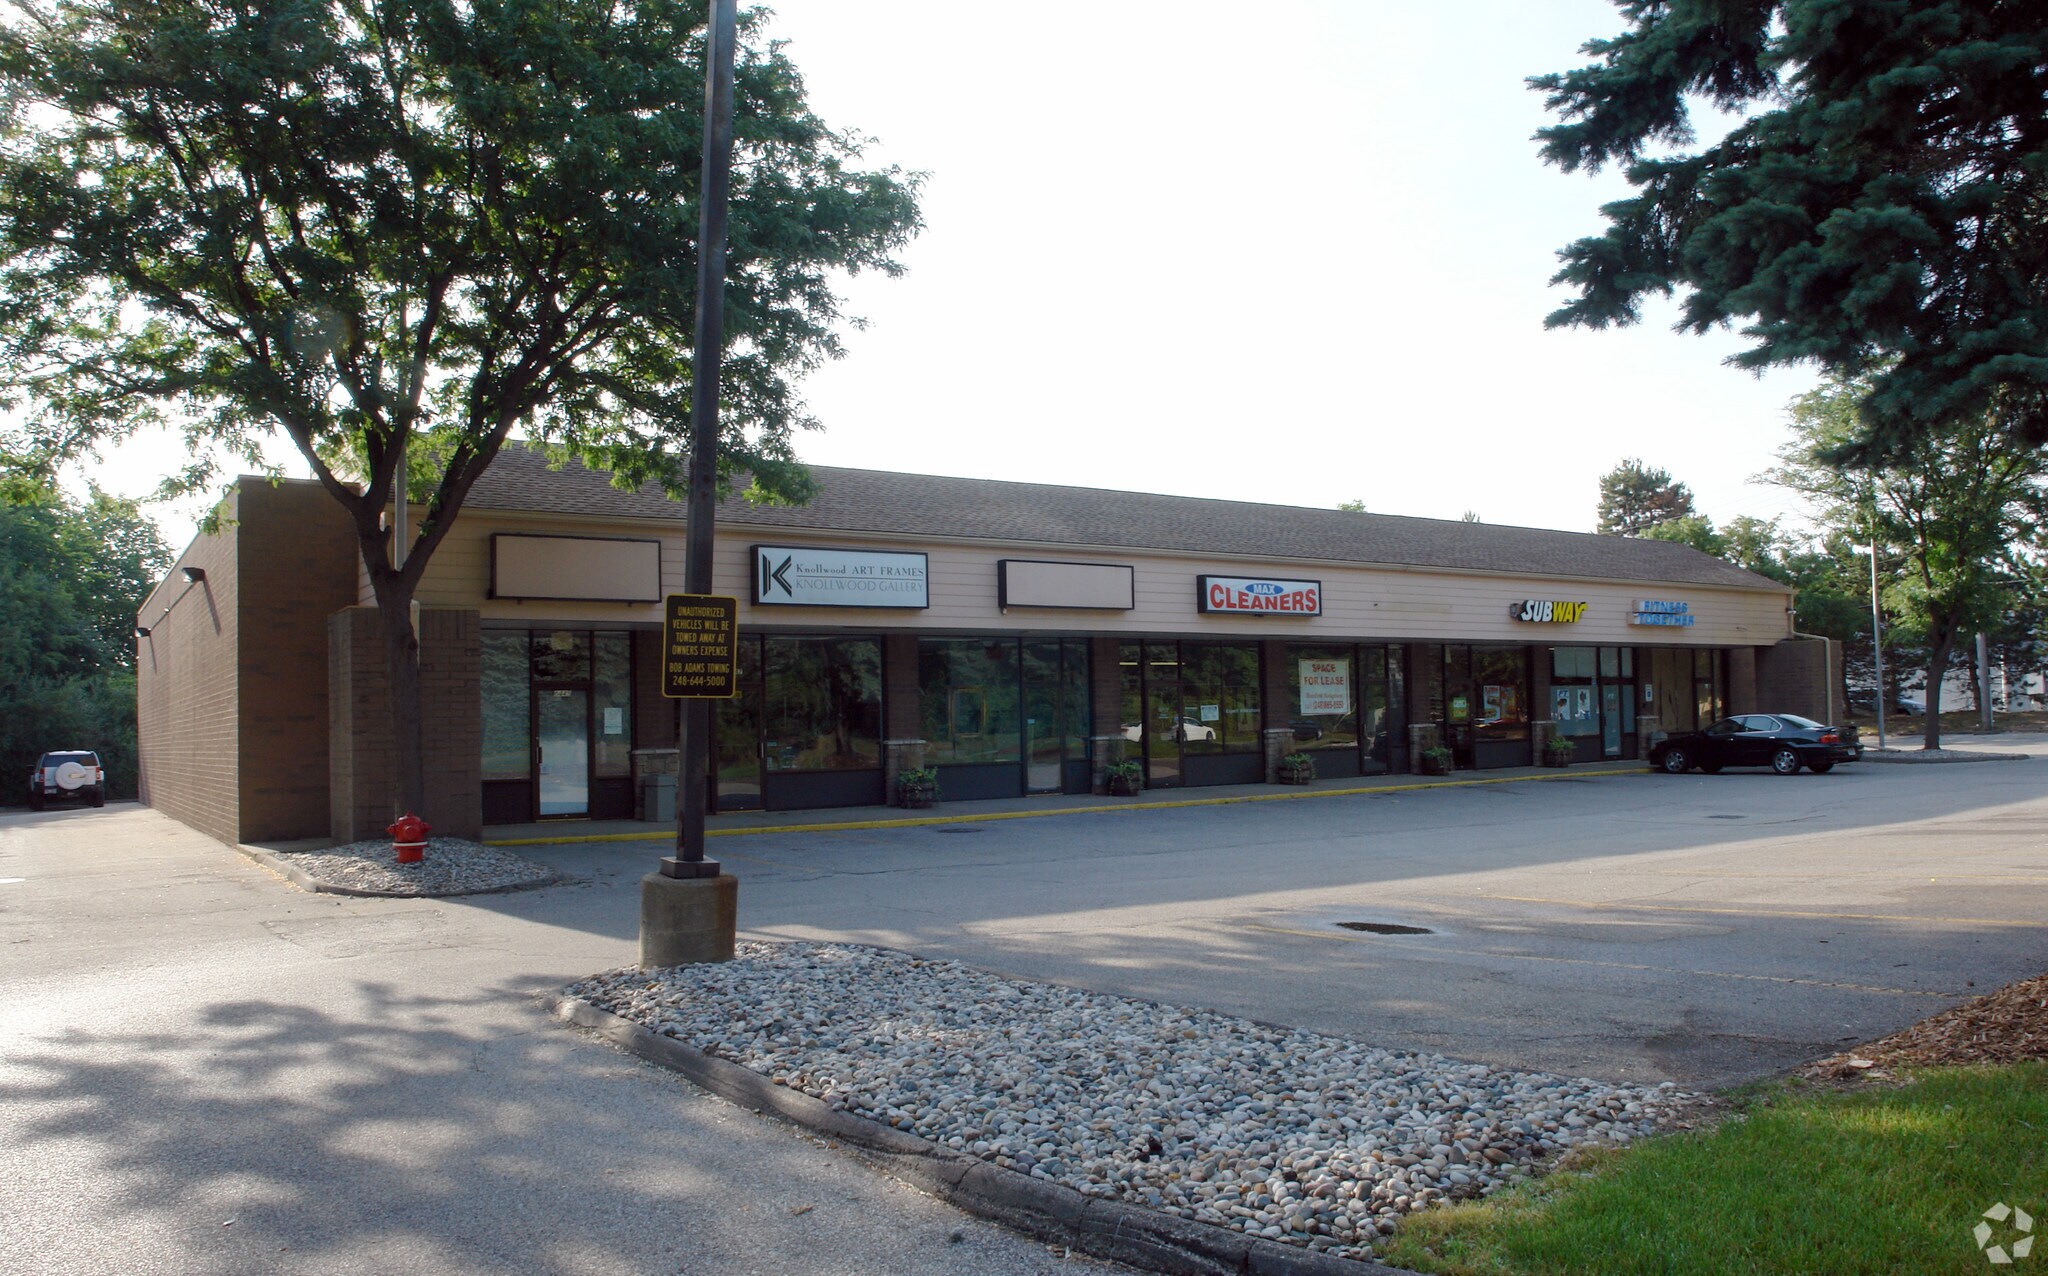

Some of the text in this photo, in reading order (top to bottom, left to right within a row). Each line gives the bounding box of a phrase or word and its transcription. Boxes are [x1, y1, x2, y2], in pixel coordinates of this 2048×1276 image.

[796, 563, 924, 577] Knollwood ART FRAMES
[796, 579, 924, 593] KNOLLWOOD GALLERY
[1253, 584, 1275, 595] MAX
[1210, 584, 1317, 612] CLEANERS
[677, 606, 725, 617] UNAUTHORIZED
[1521, 600, 1588, 623] SUBWAY
[1643, 600, 1688, 614] FITNESS
[672, 618, 730, 630] VEHICLES WILL BE
[1638, 613, 1695, 626] TOGETHER
[675, 632, 726, 643] TOWED AWAY AT
[672, 645, 728, 656] OWNERS EXPENSE
[669, 663, 682, 672] BOB
[684, 663, 705, 673] ADAMS
[707, 663, 730, 673] TOWING
[1311, 663, 1336, 673] SPACE
[672, 675, 726, 686] 248-644-5000
[1303, 676, 1344, 686] FOR LEASE
